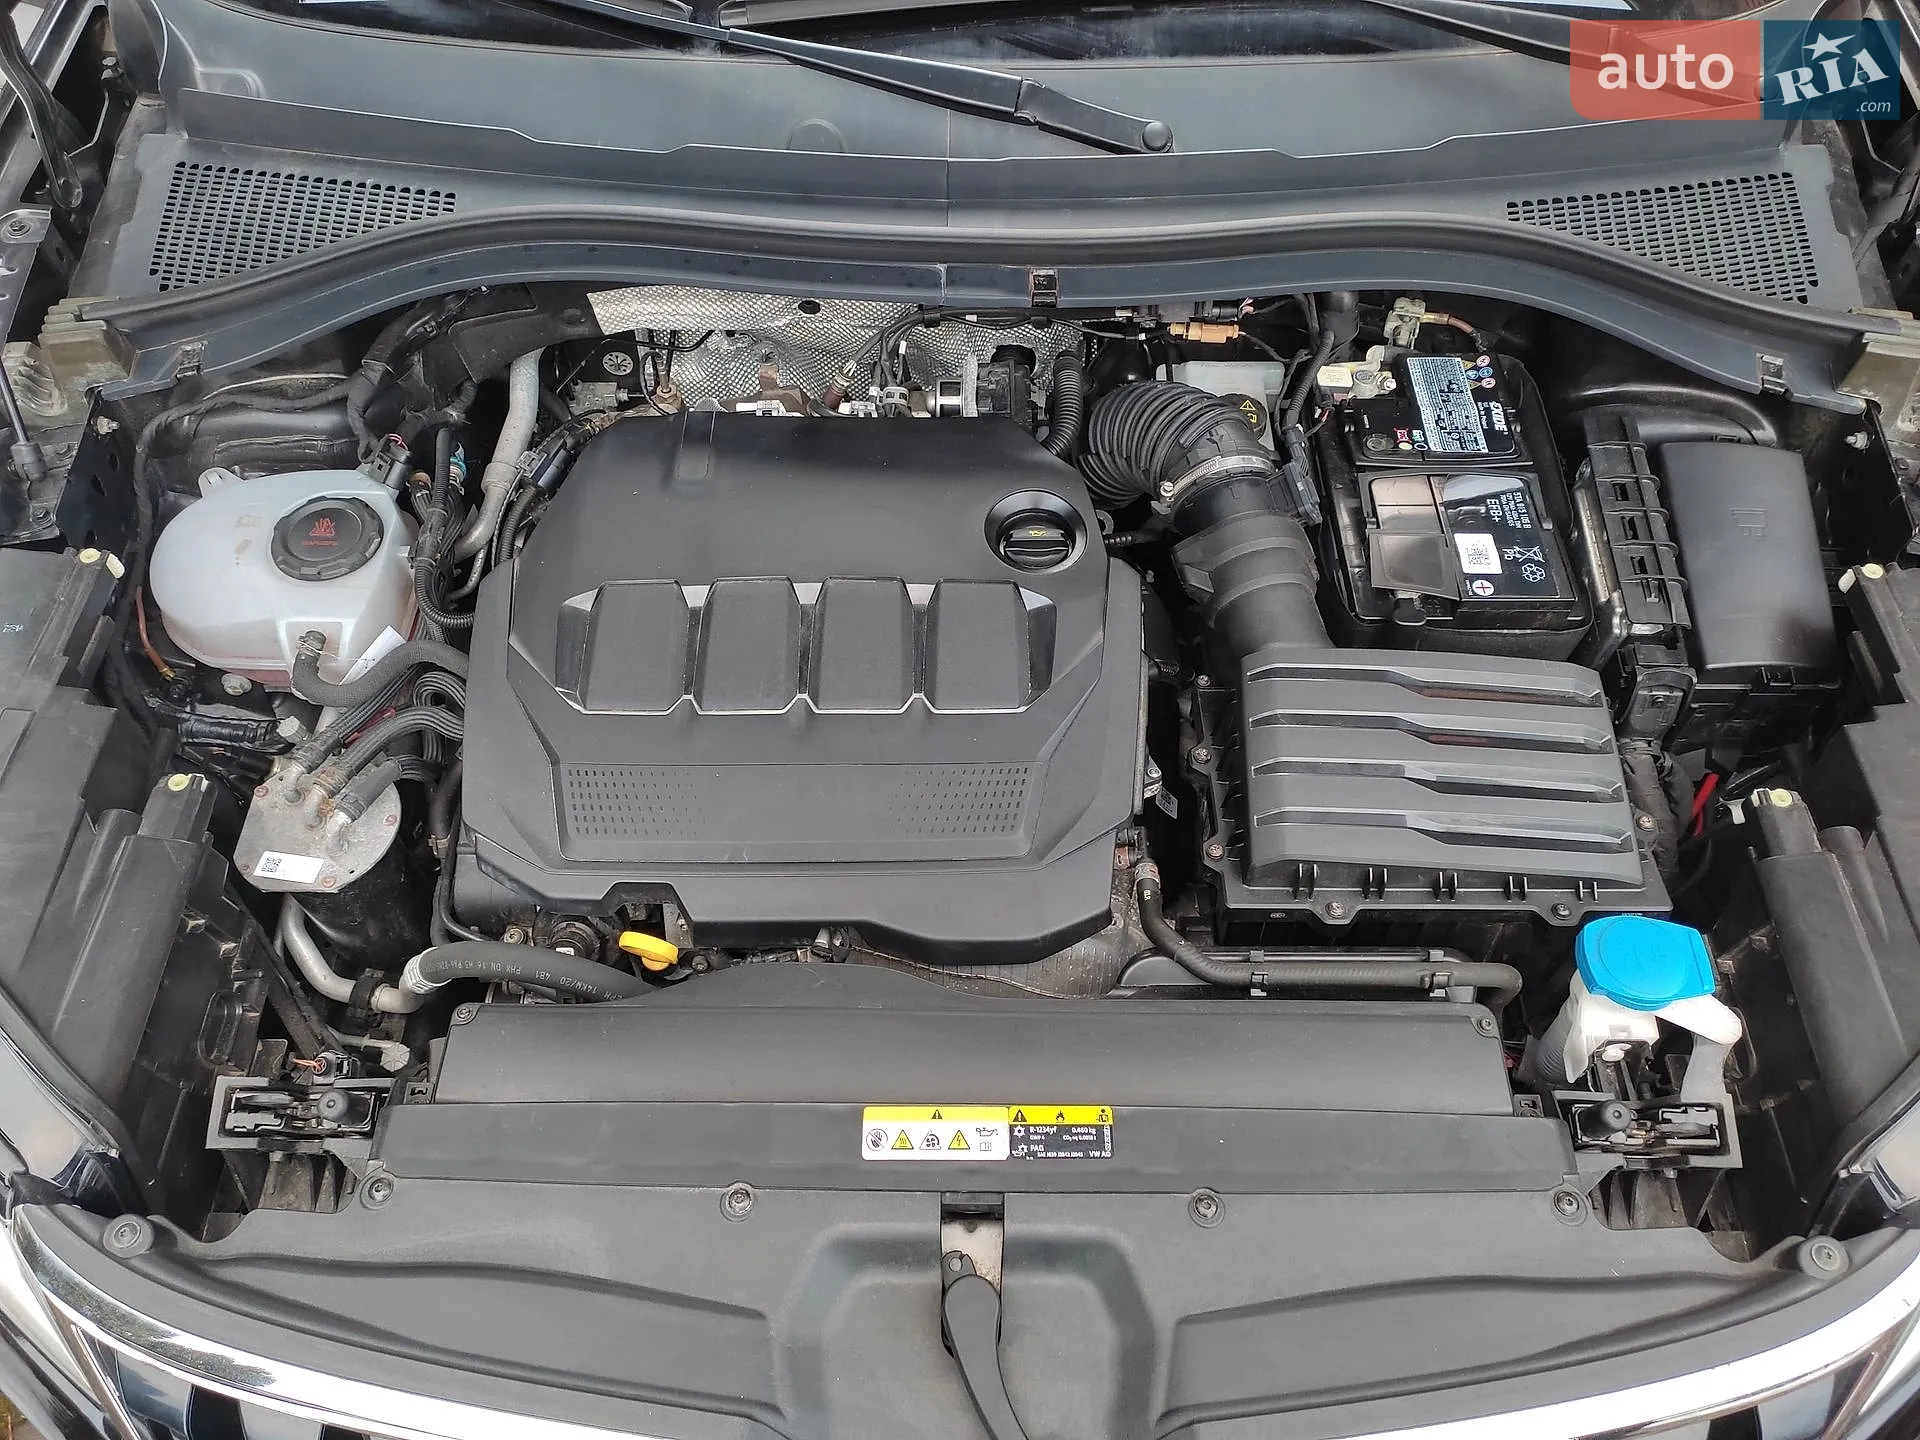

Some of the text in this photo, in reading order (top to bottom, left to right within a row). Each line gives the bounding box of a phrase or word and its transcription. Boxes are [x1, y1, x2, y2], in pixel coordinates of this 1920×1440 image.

[1489, 401, 1508, 431] EXIDE
[1486, 498, 1502, 522] EFB+
[1502, 548, 1515, 560] Pb
[1029, 1126, 1057, 1135] R-1234yf
[1088, 1127, 1097, 1135] kg
